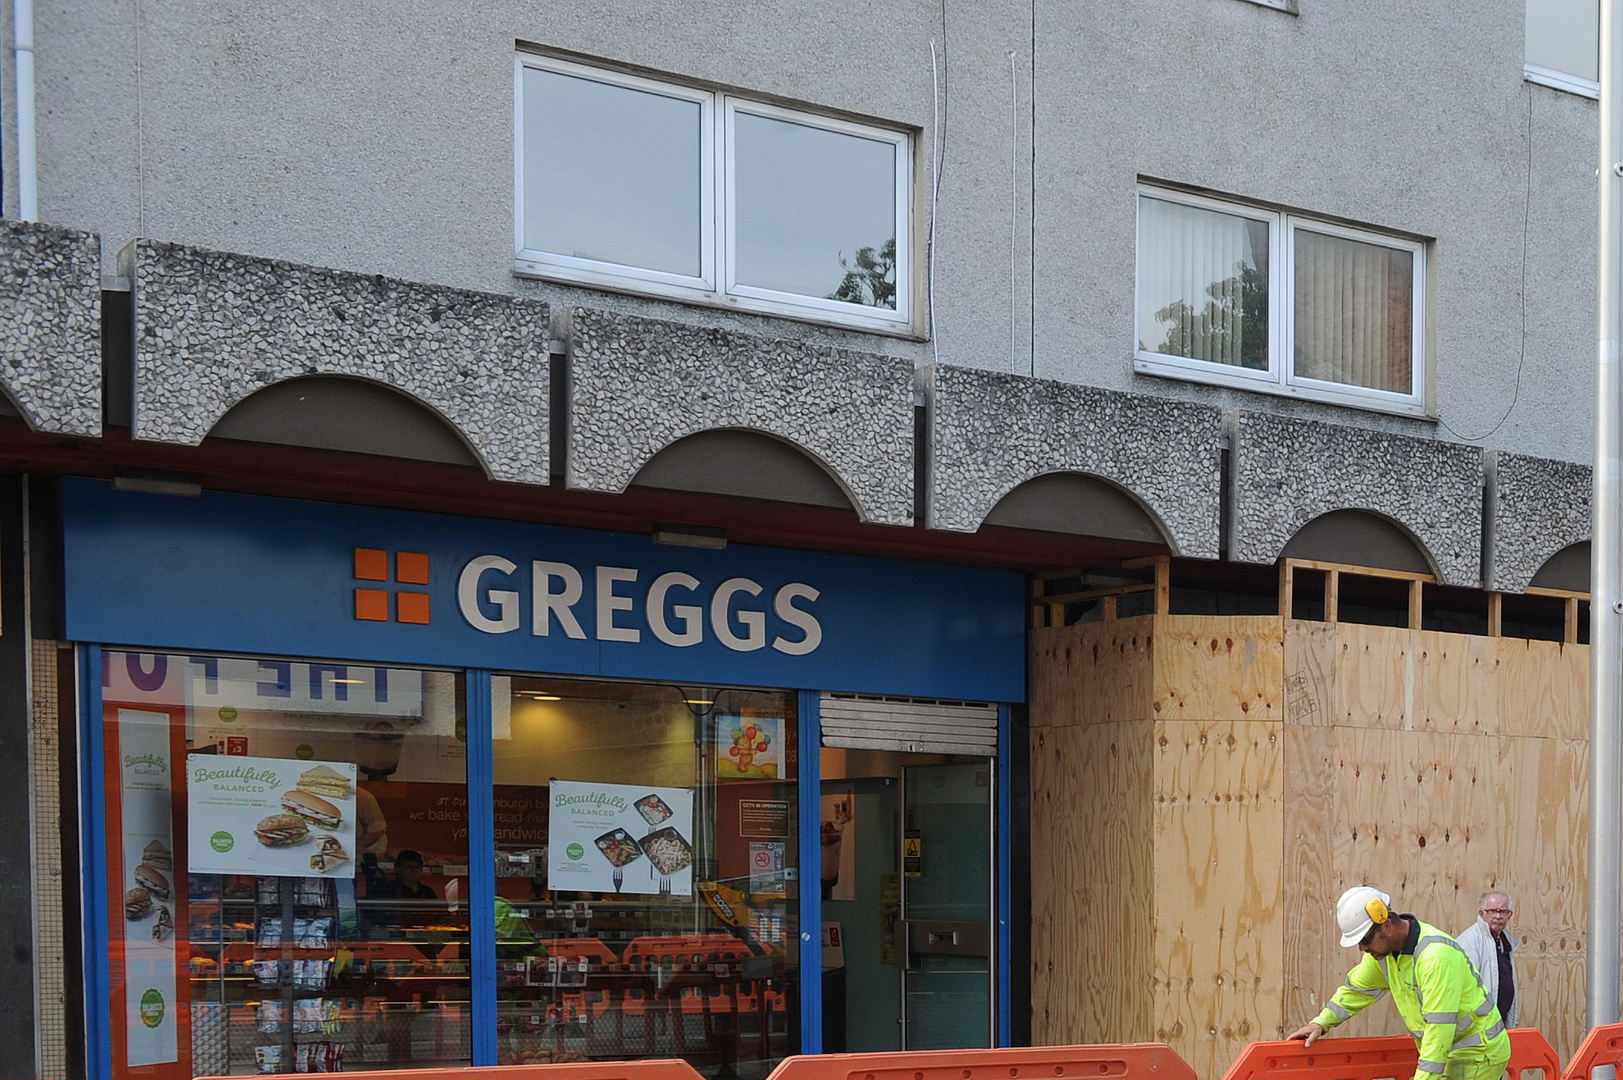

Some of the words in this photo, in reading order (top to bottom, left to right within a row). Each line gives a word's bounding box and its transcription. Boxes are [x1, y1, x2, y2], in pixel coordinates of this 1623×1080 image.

[458, 555, 822, 655] GREGGS
[124, 753, 167, 773] Beautifully
[134, 768, 160, 776] BALANCED
[194, 766, 282, 789] Beautifully
[214, 784, 265, 793] BALANCED
[453, 797, 466, 807] ou
[493, 799, 533, 811] nburgh
[555, 792, 629, 813] Beautifully
[409, 812, 424, 820] we
[428, 808, 461, 821] bake
[494, 812, 523, 823] read
[571, 808, 615, 817] BALANCED
[494, 824, 548, 840] andwic
